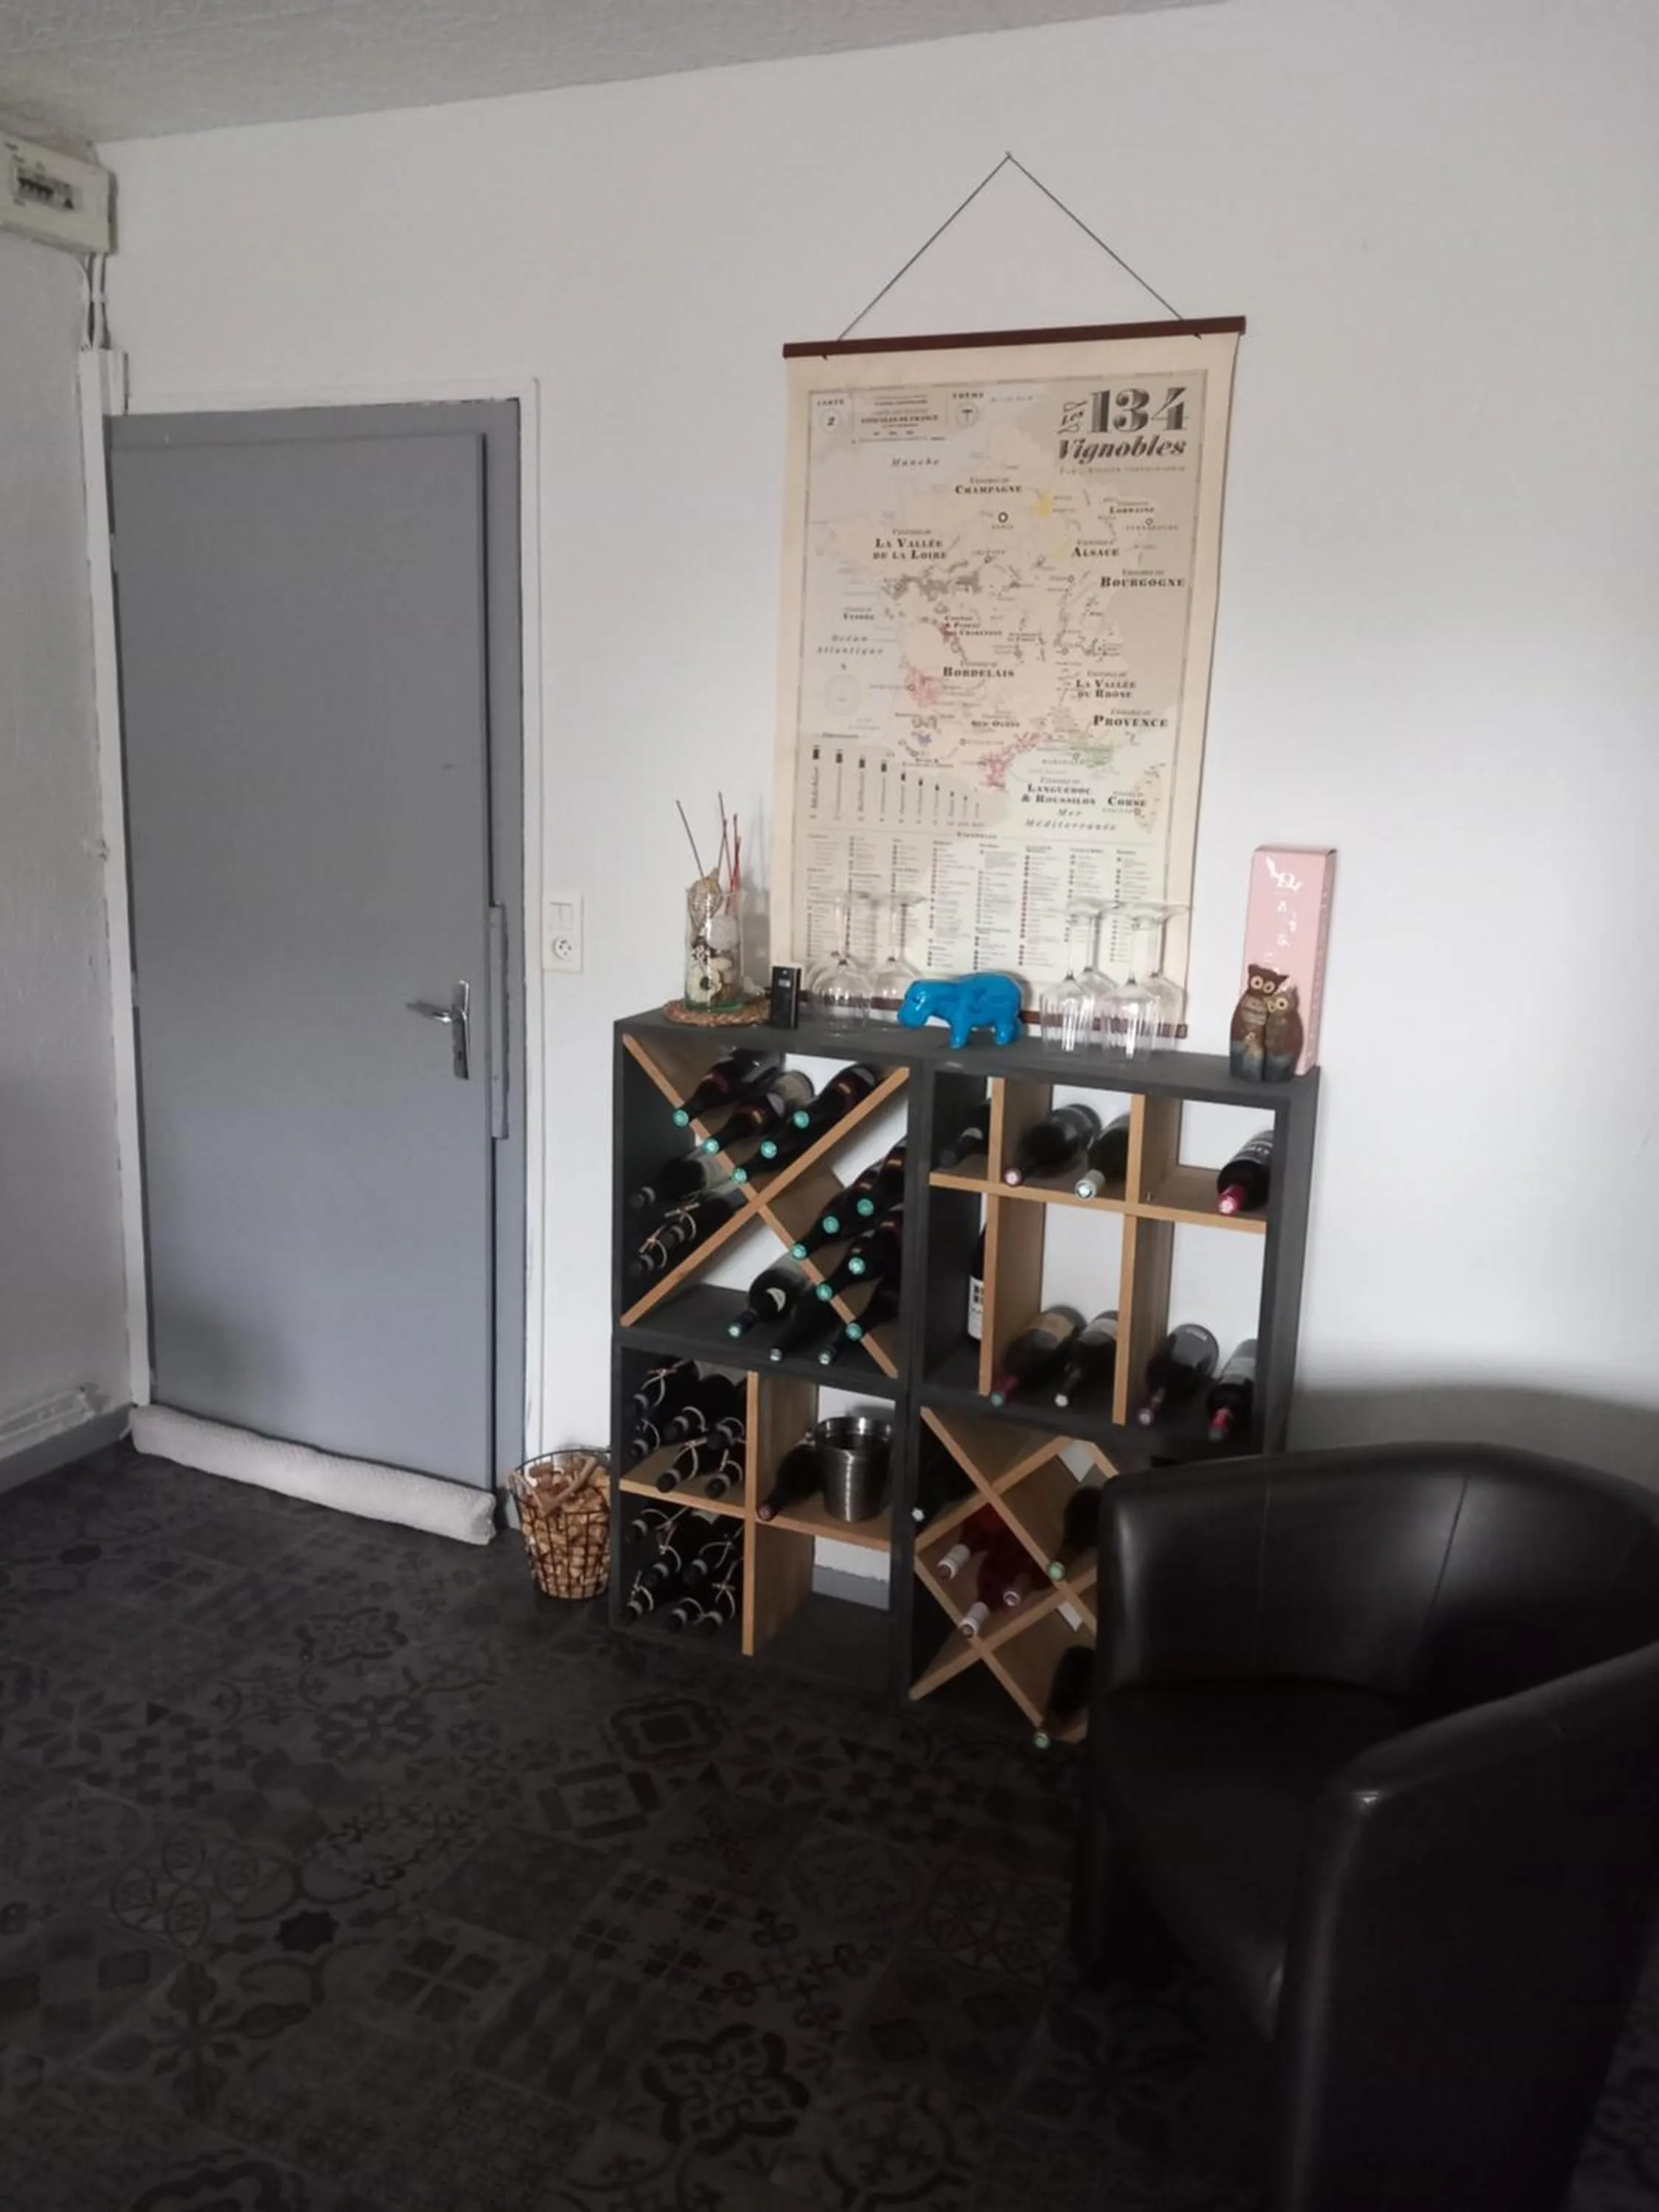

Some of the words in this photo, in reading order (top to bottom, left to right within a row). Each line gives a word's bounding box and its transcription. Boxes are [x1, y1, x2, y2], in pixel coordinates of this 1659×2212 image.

[1089, 386, 1189, 433] 134
[1058, 435, 1187, 465] Vignobles
[1093, 714, 1169, 728] PROVENCE
